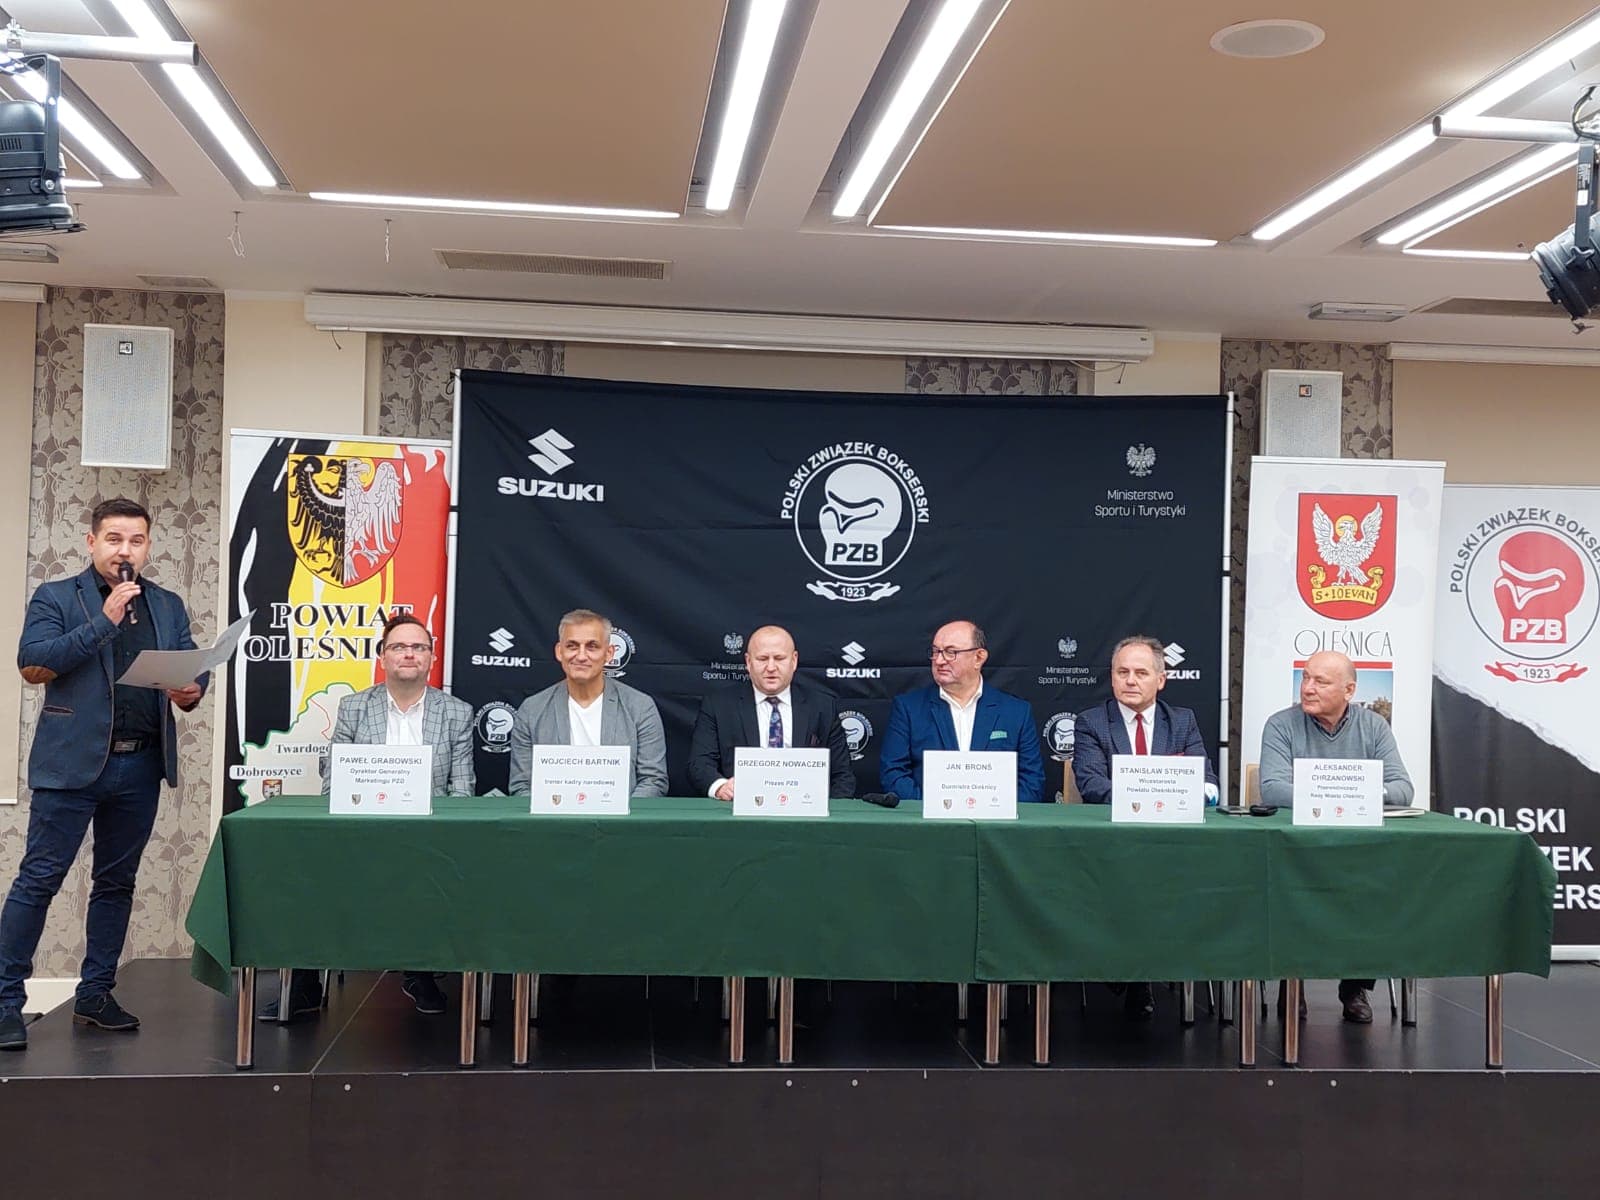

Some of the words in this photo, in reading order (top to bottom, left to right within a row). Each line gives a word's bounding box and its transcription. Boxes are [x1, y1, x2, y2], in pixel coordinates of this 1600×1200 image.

[781, 465, 811, 519] POLSKI
[808, 441, 875, 469] ZWIĄZEK
[877, 447, 929, 523] BOKSERSKI
[497, 477, 605, 502] SUZUKI
[1107, 489, 1174, 501] Ministerstwo
[1094, 505, 1130, 518] Sportu
[1132, 504, 1136, 516] i
[1139, 505, 1186, 518] Turystyki
[831, 543, 878, 563] PZB
[1450, 533, 1481, 593] POLSKI
[1477, 508, 1551, 538] ZWIĄZEK
[1555, 513, 1600, 563] BOKSE
[841, 587, 866, 597] 1923
[1509, 618, 1563, 641] PZB
[244, 630, 437, 661] OLEŚNI
[471, 655, 530, 667] SUZUKI
[826, 668, 880, 679] SUZUKI
[1165, 670, 1200, 680] ZUKI
[1523, 668, 1551, 679] 1923
[276, 743, 329, 754] Twardog
[340, 756, 368, 764] PAWEŁ
[371, 757, 422, 765] GRABOWSKI
[782, 760, 826, 768] NOWACZEK
[236, 767, 302, 779] Dobroszyce
[1311, 774, 1365, 782] CHRZANOWSKI
[1453, 807, 1566, 833] POLSKI
